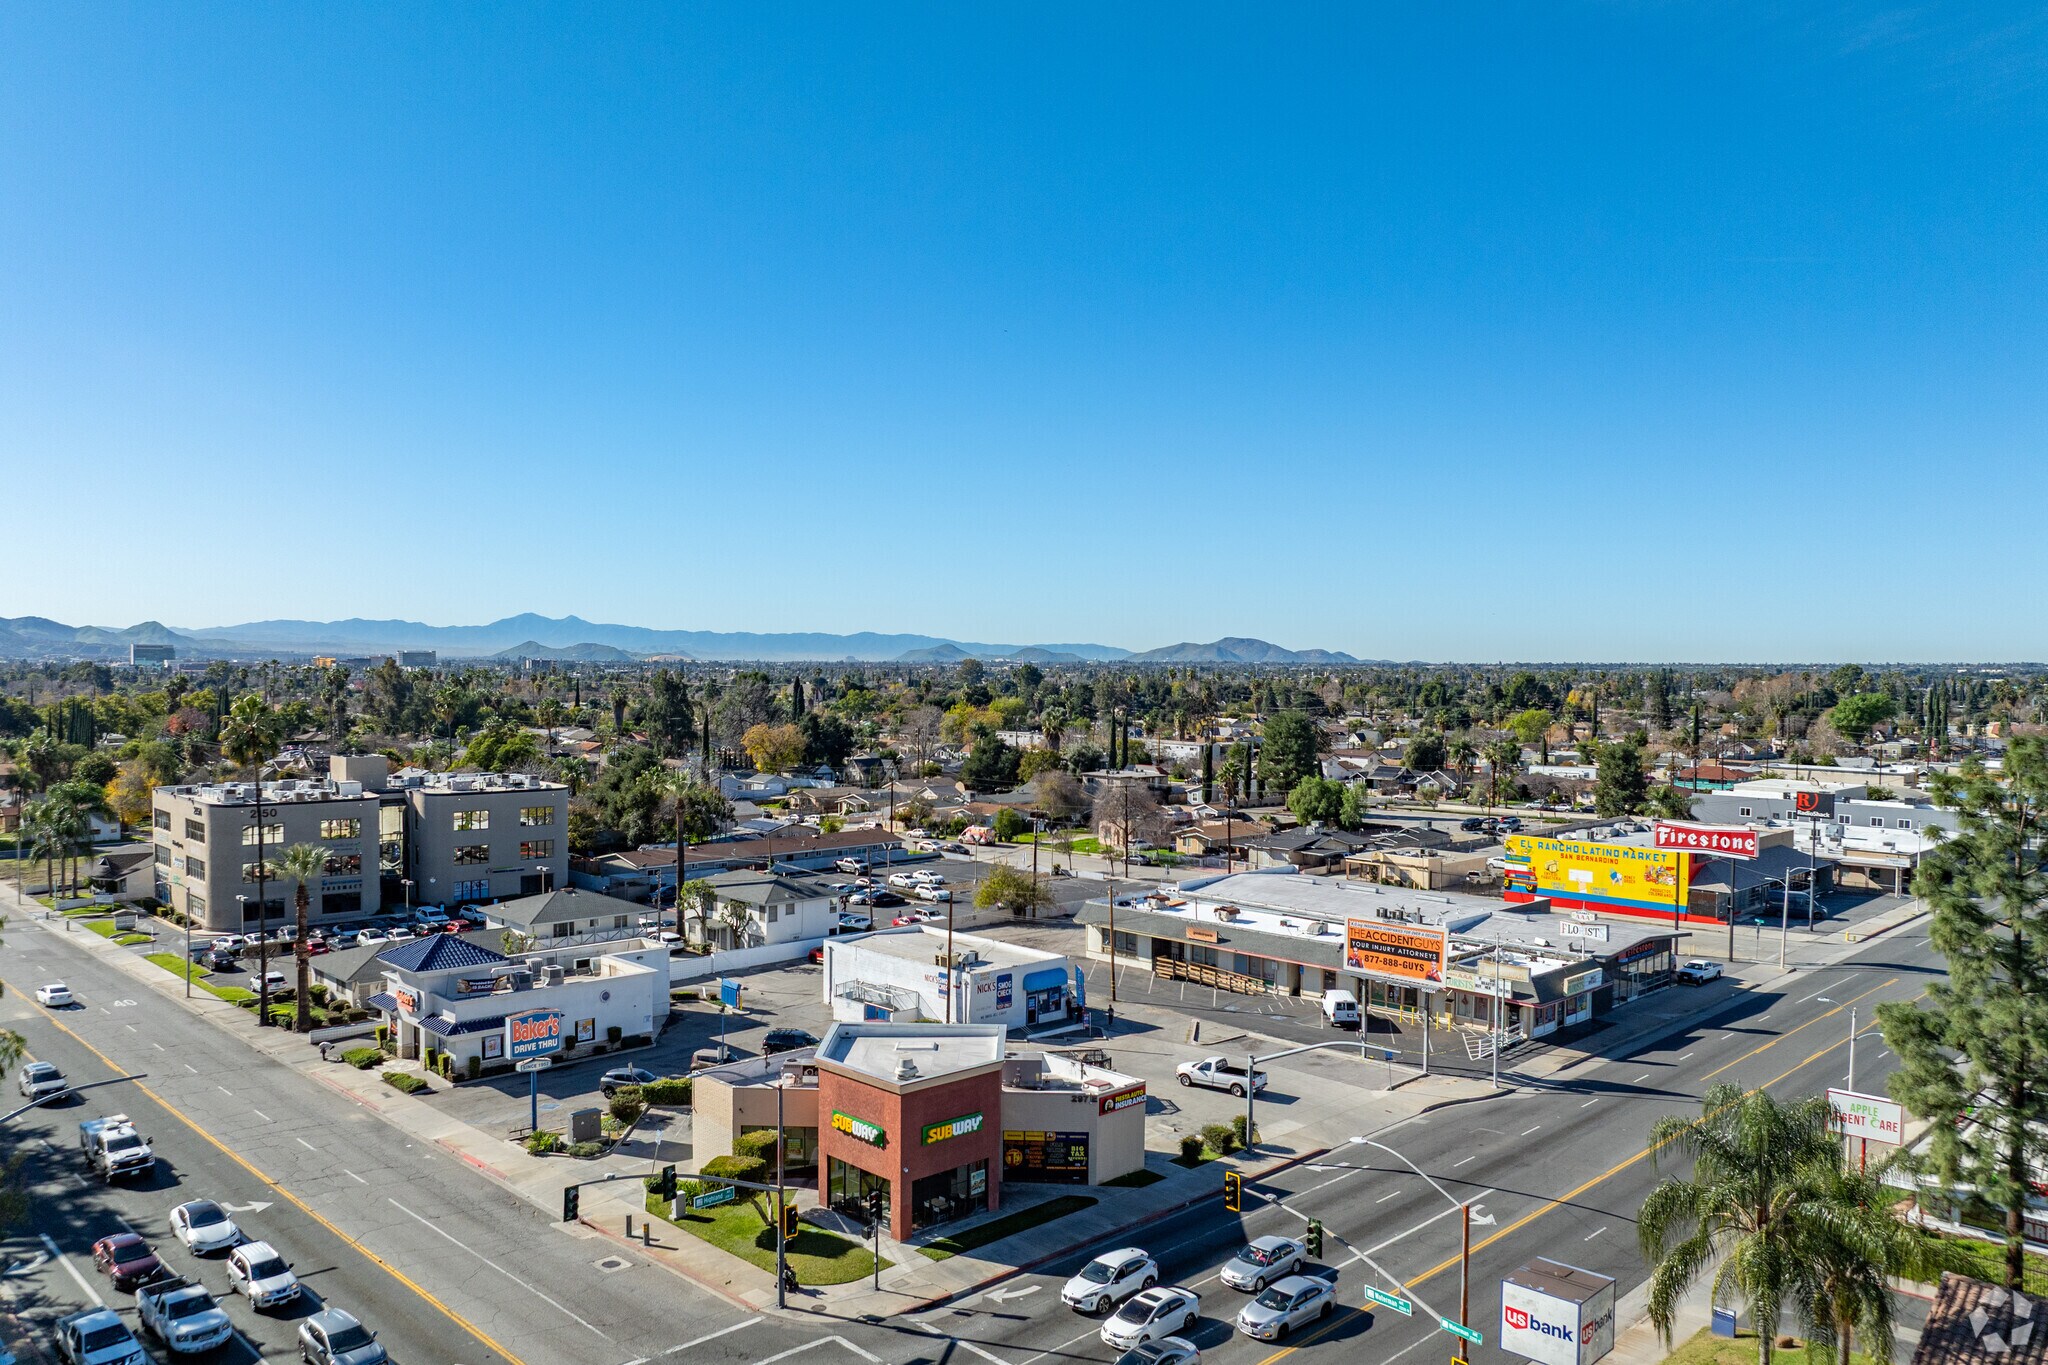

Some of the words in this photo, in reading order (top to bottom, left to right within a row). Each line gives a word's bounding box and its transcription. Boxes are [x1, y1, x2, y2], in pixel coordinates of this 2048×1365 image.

[250, 808, 278, 818] 250
[1656, 826, 1755, 851] Firestone
[1520, 839, 1533, 849] EL
[1537, 841, 1579, 854] RANCHO
[1581, 845, 1620, 858] LATINO
[1622, 850, 1667, 863] MARKET
[1560, 852, 1574, 860] SAN
[1576, 854, 1619, 865] BERNARDINO
[1351, 940, 1370, 949] YOUR
[1371, 944, 1395, 956] INJURY
[1397, 948, 1437, 960] ATTORNEYS
[1364, 954, 1425, 972] 877-888-GUYS
[976, 981, 996, 994] NICK'S
[997, 980, 1012, 989] SMOG
[997, 988, 1012, 998] CHECK
[512, 1014, 559, 1042] Baker's
[514, 1042, 537, 1053] DRIVE
[538, 1038, 558, 1050] THRU
[522, 1062, 537, 1070] SINCE
[1071, 1095, 1089, 1103] 297
[1115, 1093, 1130, 1103] FIESTA
[1130, 1089, 1144, 1098] AUTO
[1115, 1094, 1147, 1110] INSURANCE
[1850, 1103, 1879, 1117] APPLE
[832, 1113, 879, 1142] SUBWAY
[927, 1114, 983, 1144] SUBWAY
[703, 1193, 723, 1204] Highland
[1530, 1314, 1574, 1342] bank
[1594, 1308, 1612, 1333] bank
